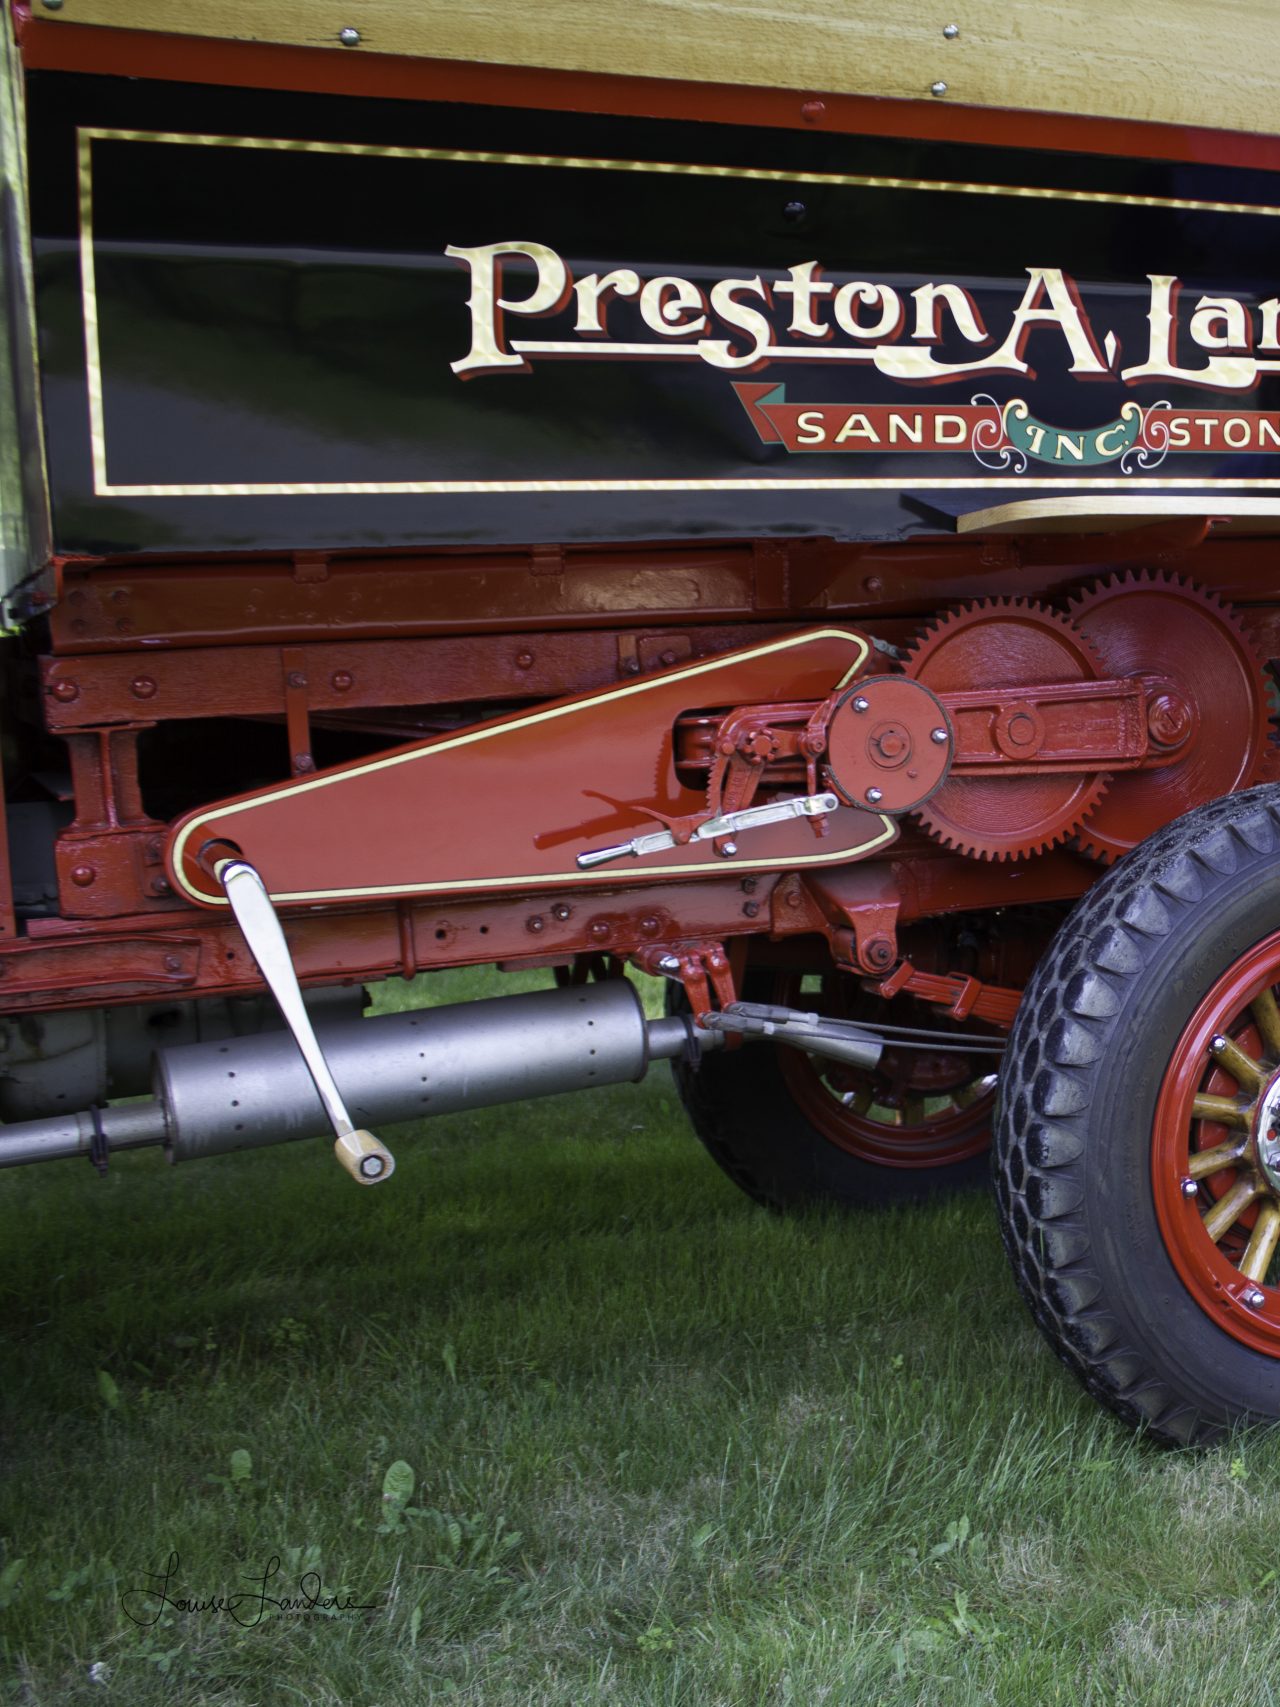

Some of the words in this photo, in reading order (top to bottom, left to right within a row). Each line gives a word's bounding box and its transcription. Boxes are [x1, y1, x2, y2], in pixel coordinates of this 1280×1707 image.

[444, 241, 990, 374] Preston
[796, 411, 968, 444] SAND
[1025, 423, 1130, 461] INC.
